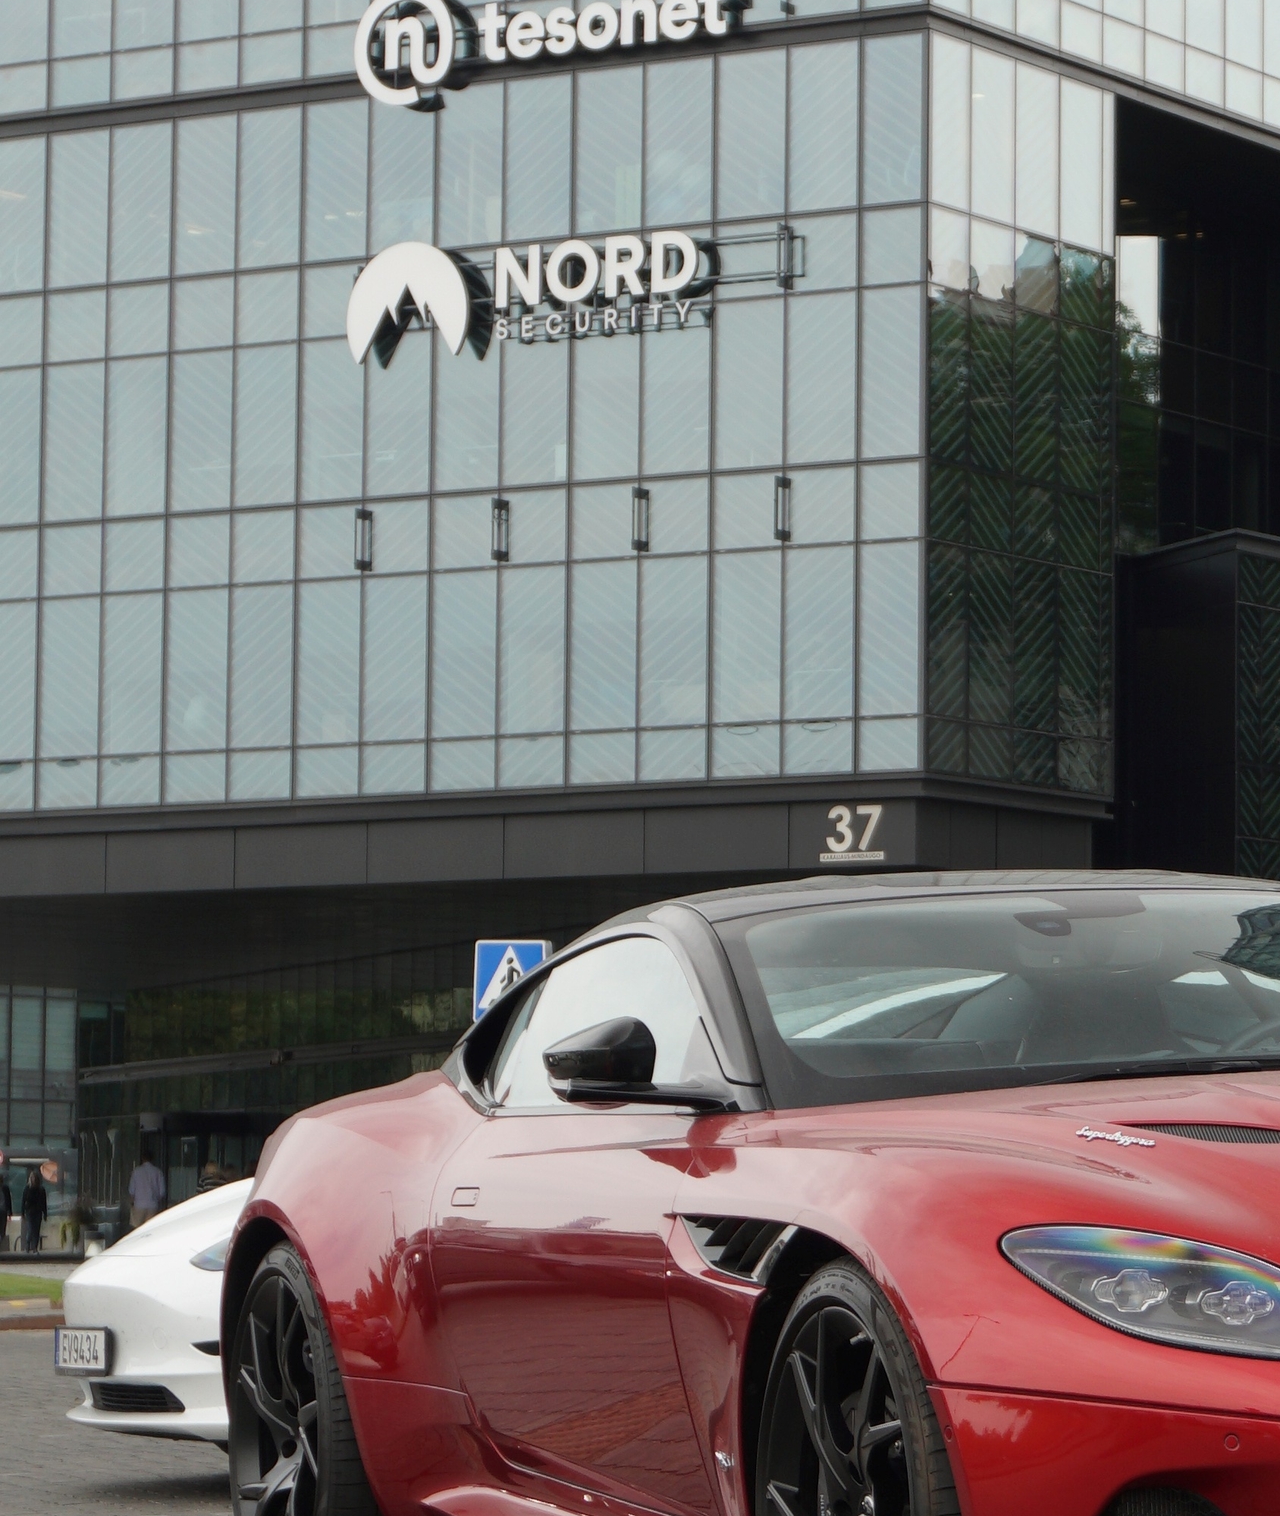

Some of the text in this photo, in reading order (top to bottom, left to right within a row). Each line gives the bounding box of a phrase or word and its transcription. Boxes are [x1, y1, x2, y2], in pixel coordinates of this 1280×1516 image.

[494, 230, 700, 309] NORD
[495, 300, 693, 341] SECURITY
[826, 804, 883, 852] 37
